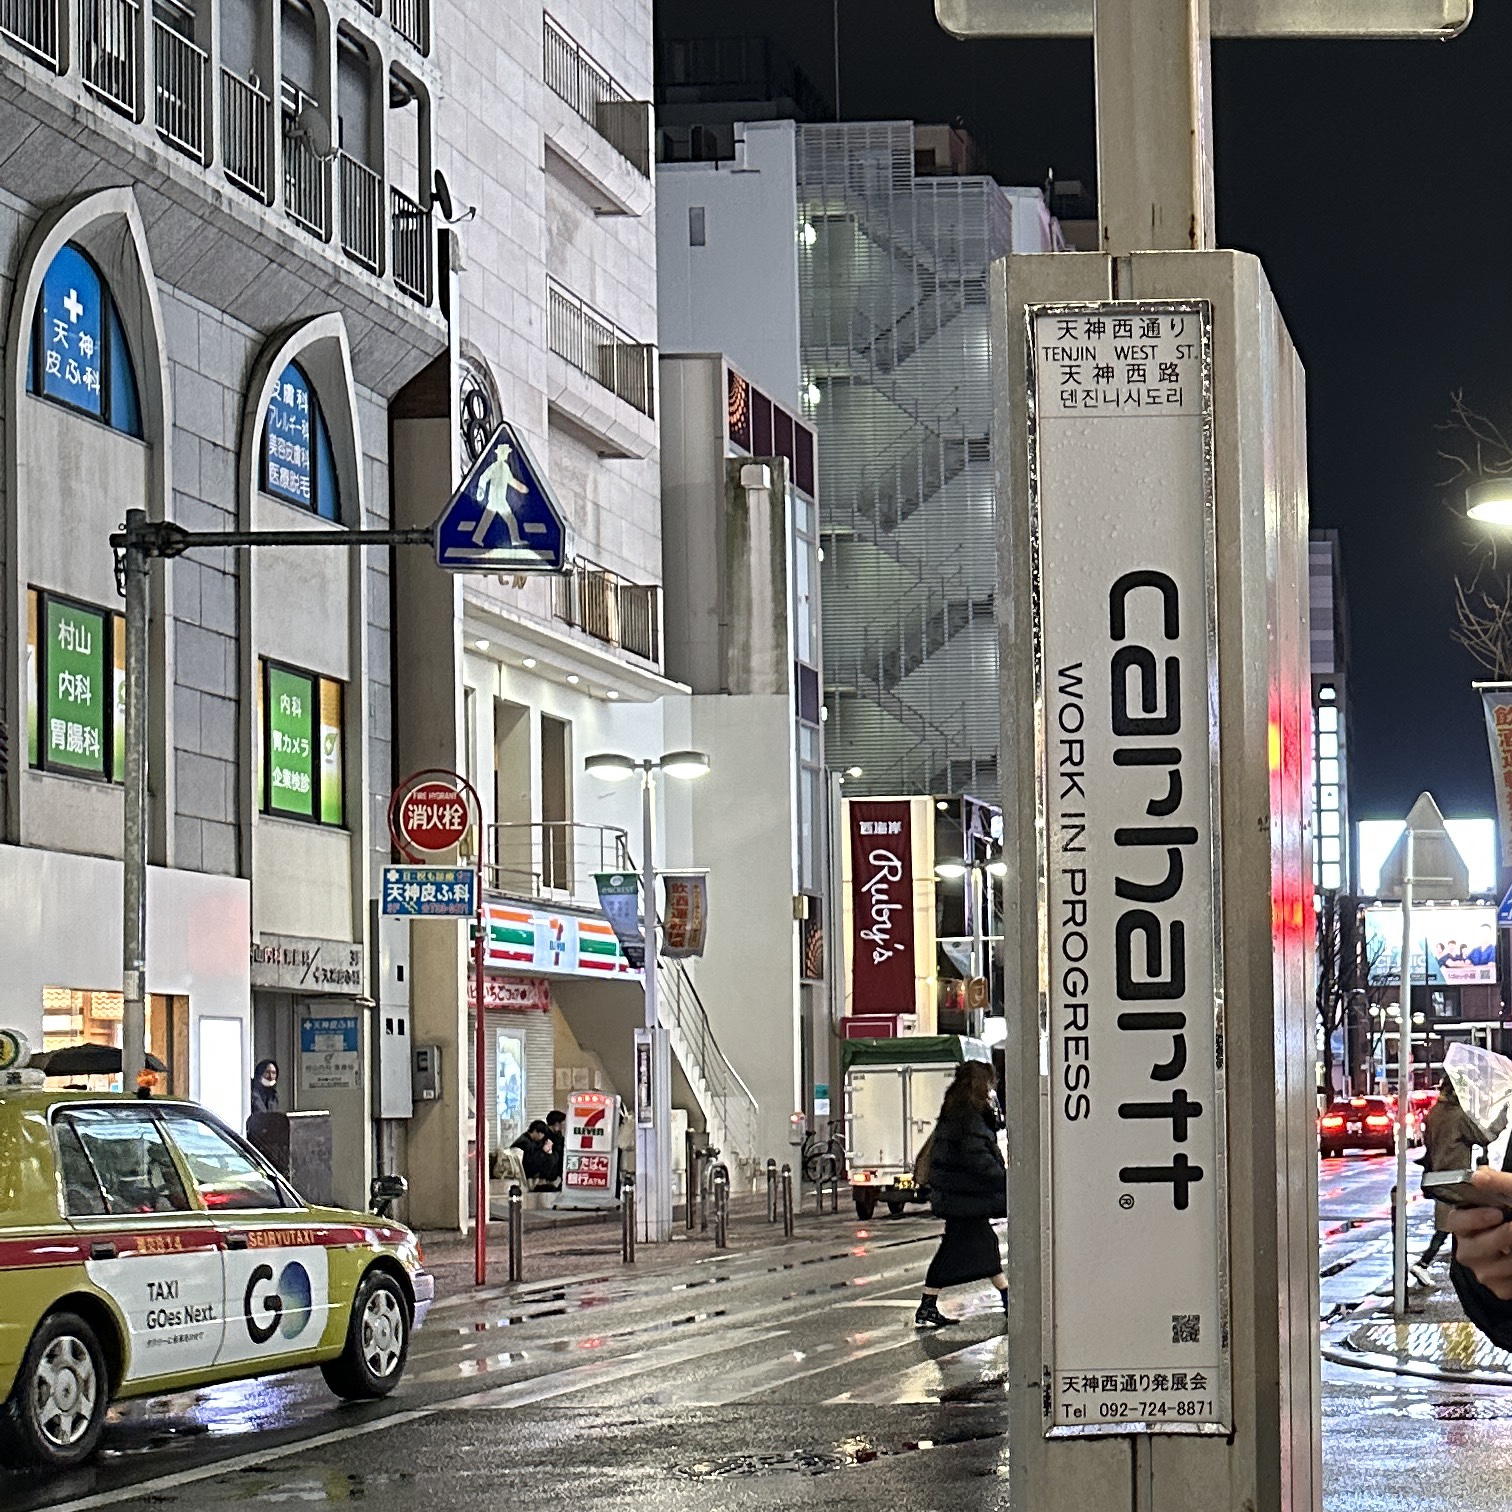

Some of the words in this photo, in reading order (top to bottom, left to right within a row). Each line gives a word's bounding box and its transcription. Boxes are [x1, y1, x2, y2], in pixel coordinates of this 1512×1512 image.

[53, 319, 94, 359] 天神
[1057, 317, 1186, 341] 天神西通り
[1042, 345, 1097, 362] TENJIN
[1114, 344, 1158, 361] WEST
[1175, 344, 1199, 360] ST.
[46, 350, 101, 396] 皮ふ科
[1060, 362, 1180, 386] 天神西路
[1060, 387, 1183, 409] 덴진니시도리
[58, 618, 91, 655] 村山
[58, 670, 92, 706] 内科
[280, 693, 302, 719] 内科
[51, 718, 101, 758] 胃腸科
[272, 729, 310, 758] 胃カメラ
[1057, 662, 1086, 799] WORK
[407, 803, 464, 830] 消火栓
[1060, 812, 1087, 853] IN
[386, 883, 470, 902] 天神皮ふ科
[1108, 570, 1204, 1211] carhartt
[860, 848, 905, 965] Ruby's
[1061, 868, 1091, 1122] PROGRESS
[574, 1107, 605, 1149] 7
[581, 1156, 608, 1171] たばこ
[147, 1279, 179, 1302] TAXI
[147, 1308, 182, 1330] GOes
[183, 1304, 218, 1325] Next.
[1061, 1372, 1208, 1394] 天神西通り発展会
[1061, 1403, 1087, 1418] Tel
[1099, 1400, 1213, 1418] 092-724-8871
